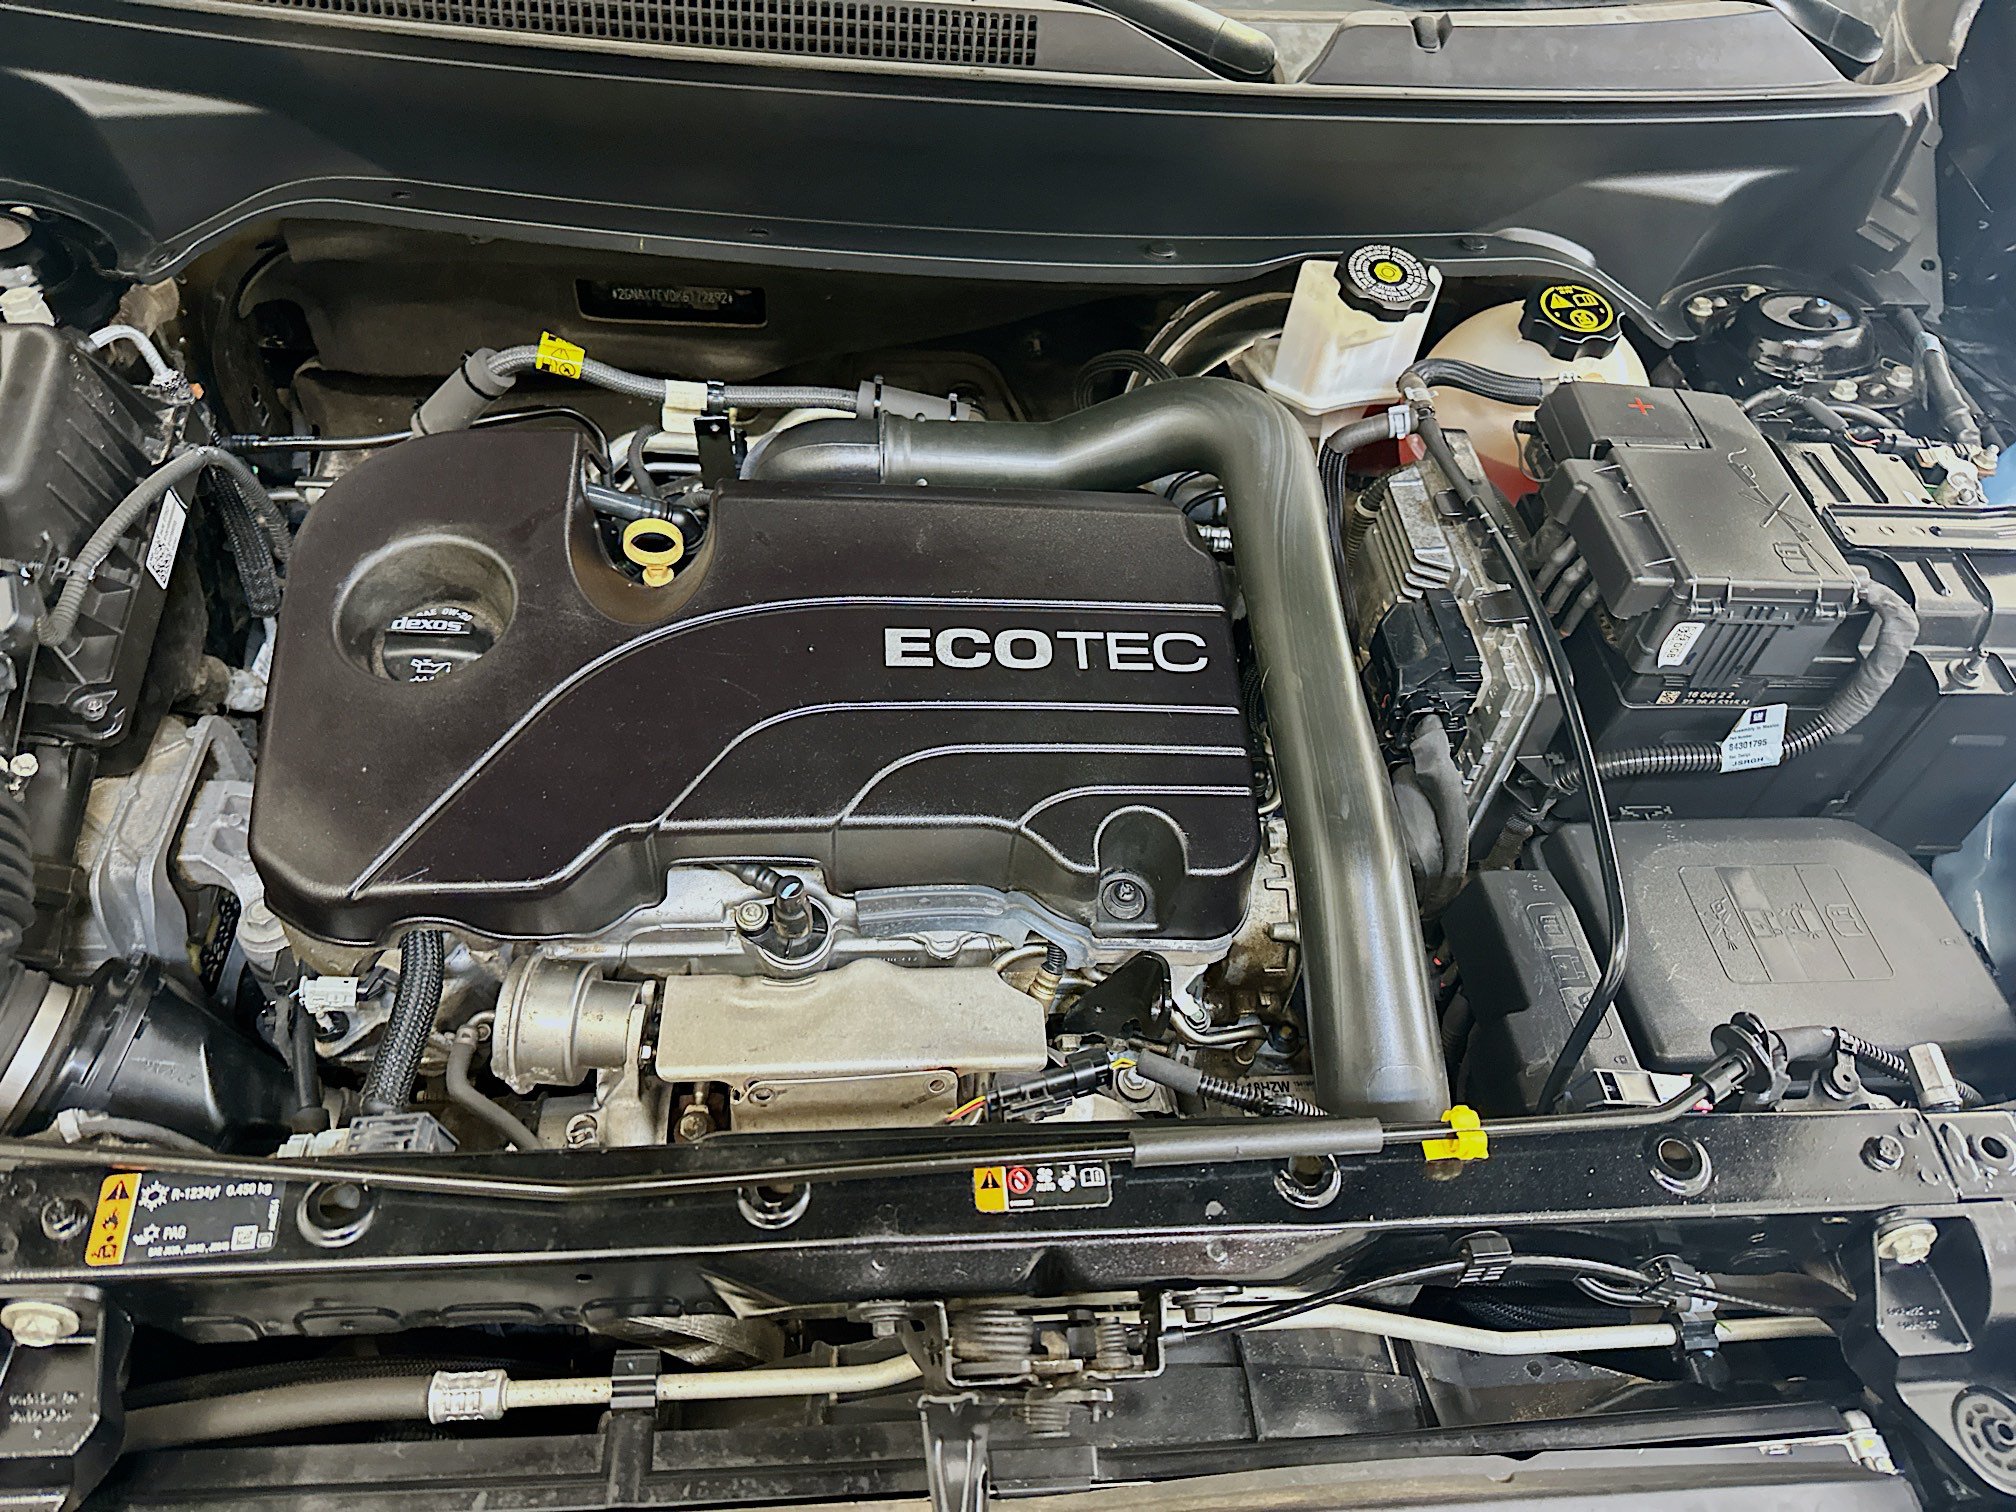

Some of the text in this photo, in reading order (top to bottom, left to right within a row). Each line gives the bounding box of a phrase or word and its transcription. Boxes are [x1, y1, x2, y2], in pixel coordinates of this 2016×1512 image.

[391, 616, 466, 632] dexos
[884, 627, 1209, 673] ECOTEC
[1729, 739, 1768, 751] 84301795
[257, 1181, 273, 1197] kg
[162, 1225, 187, 1240] PAG
